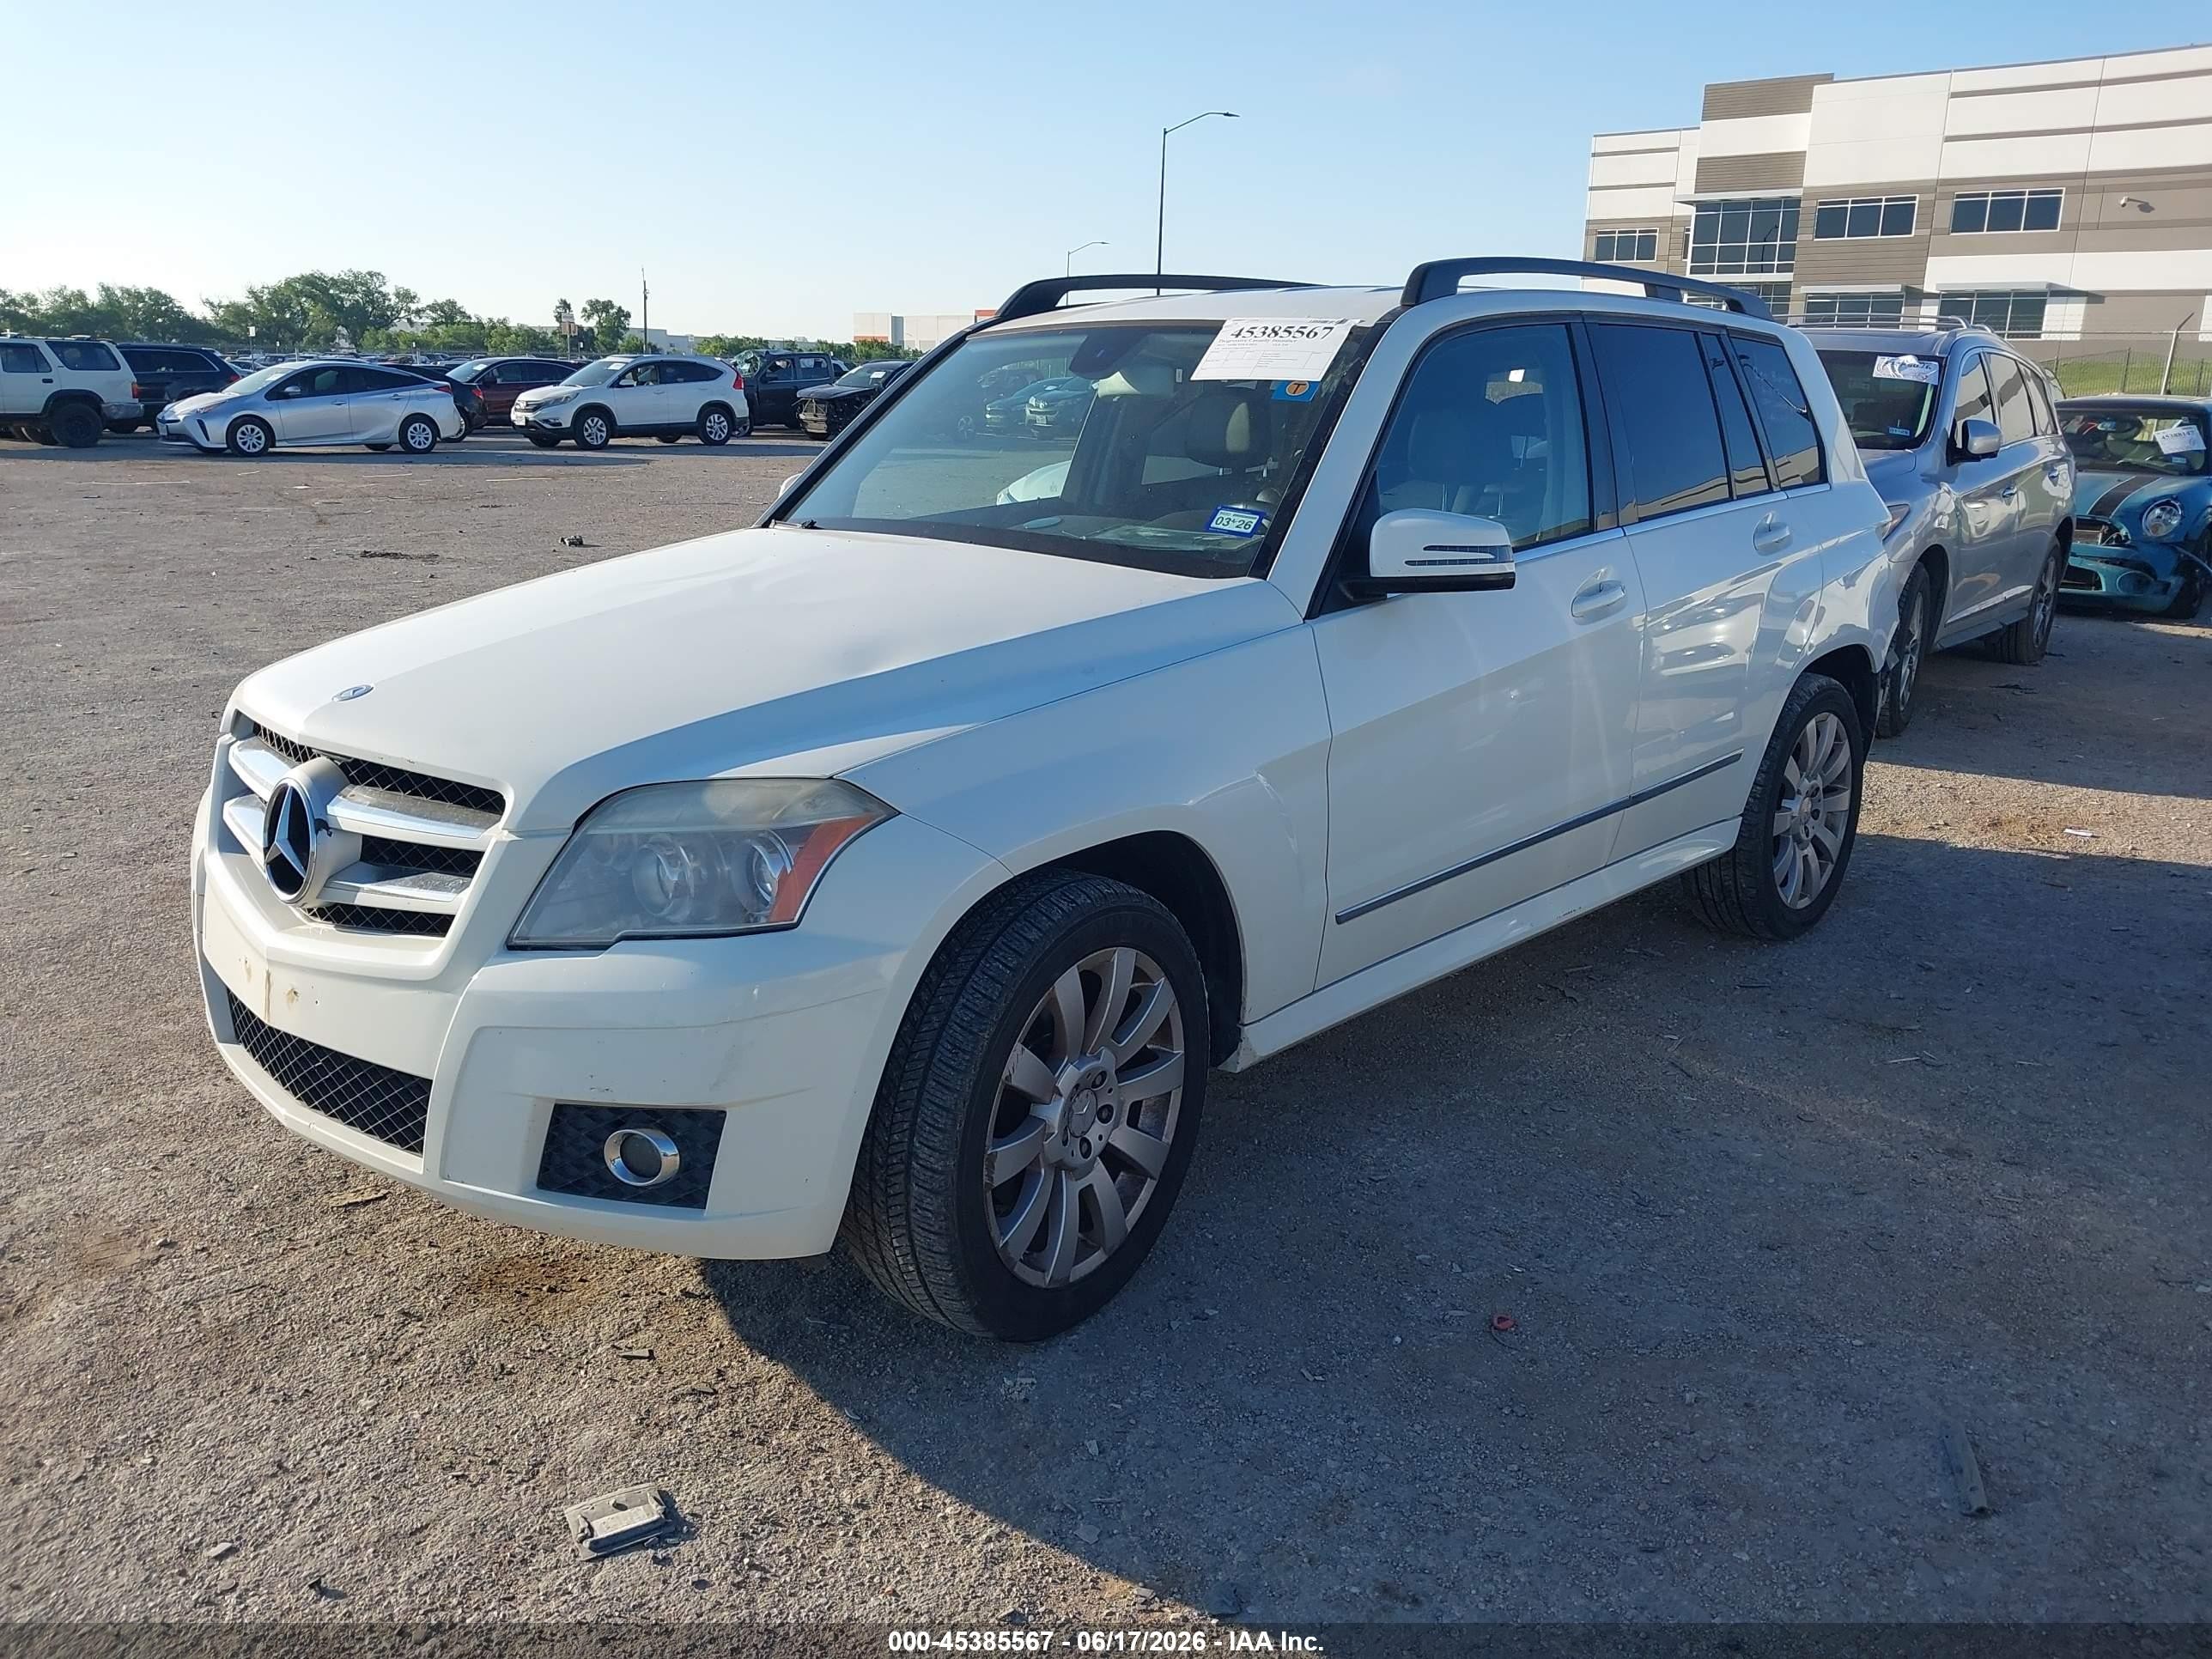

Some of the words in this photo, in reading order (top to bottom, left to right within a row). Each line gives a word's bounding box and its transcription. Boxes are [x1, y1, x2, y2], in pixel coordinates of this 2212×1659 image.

[1231, 325, 1334, 339] 45385567
[1215, 516, 1232, 526] 03
[1235, 520, 1254, 530] 26
